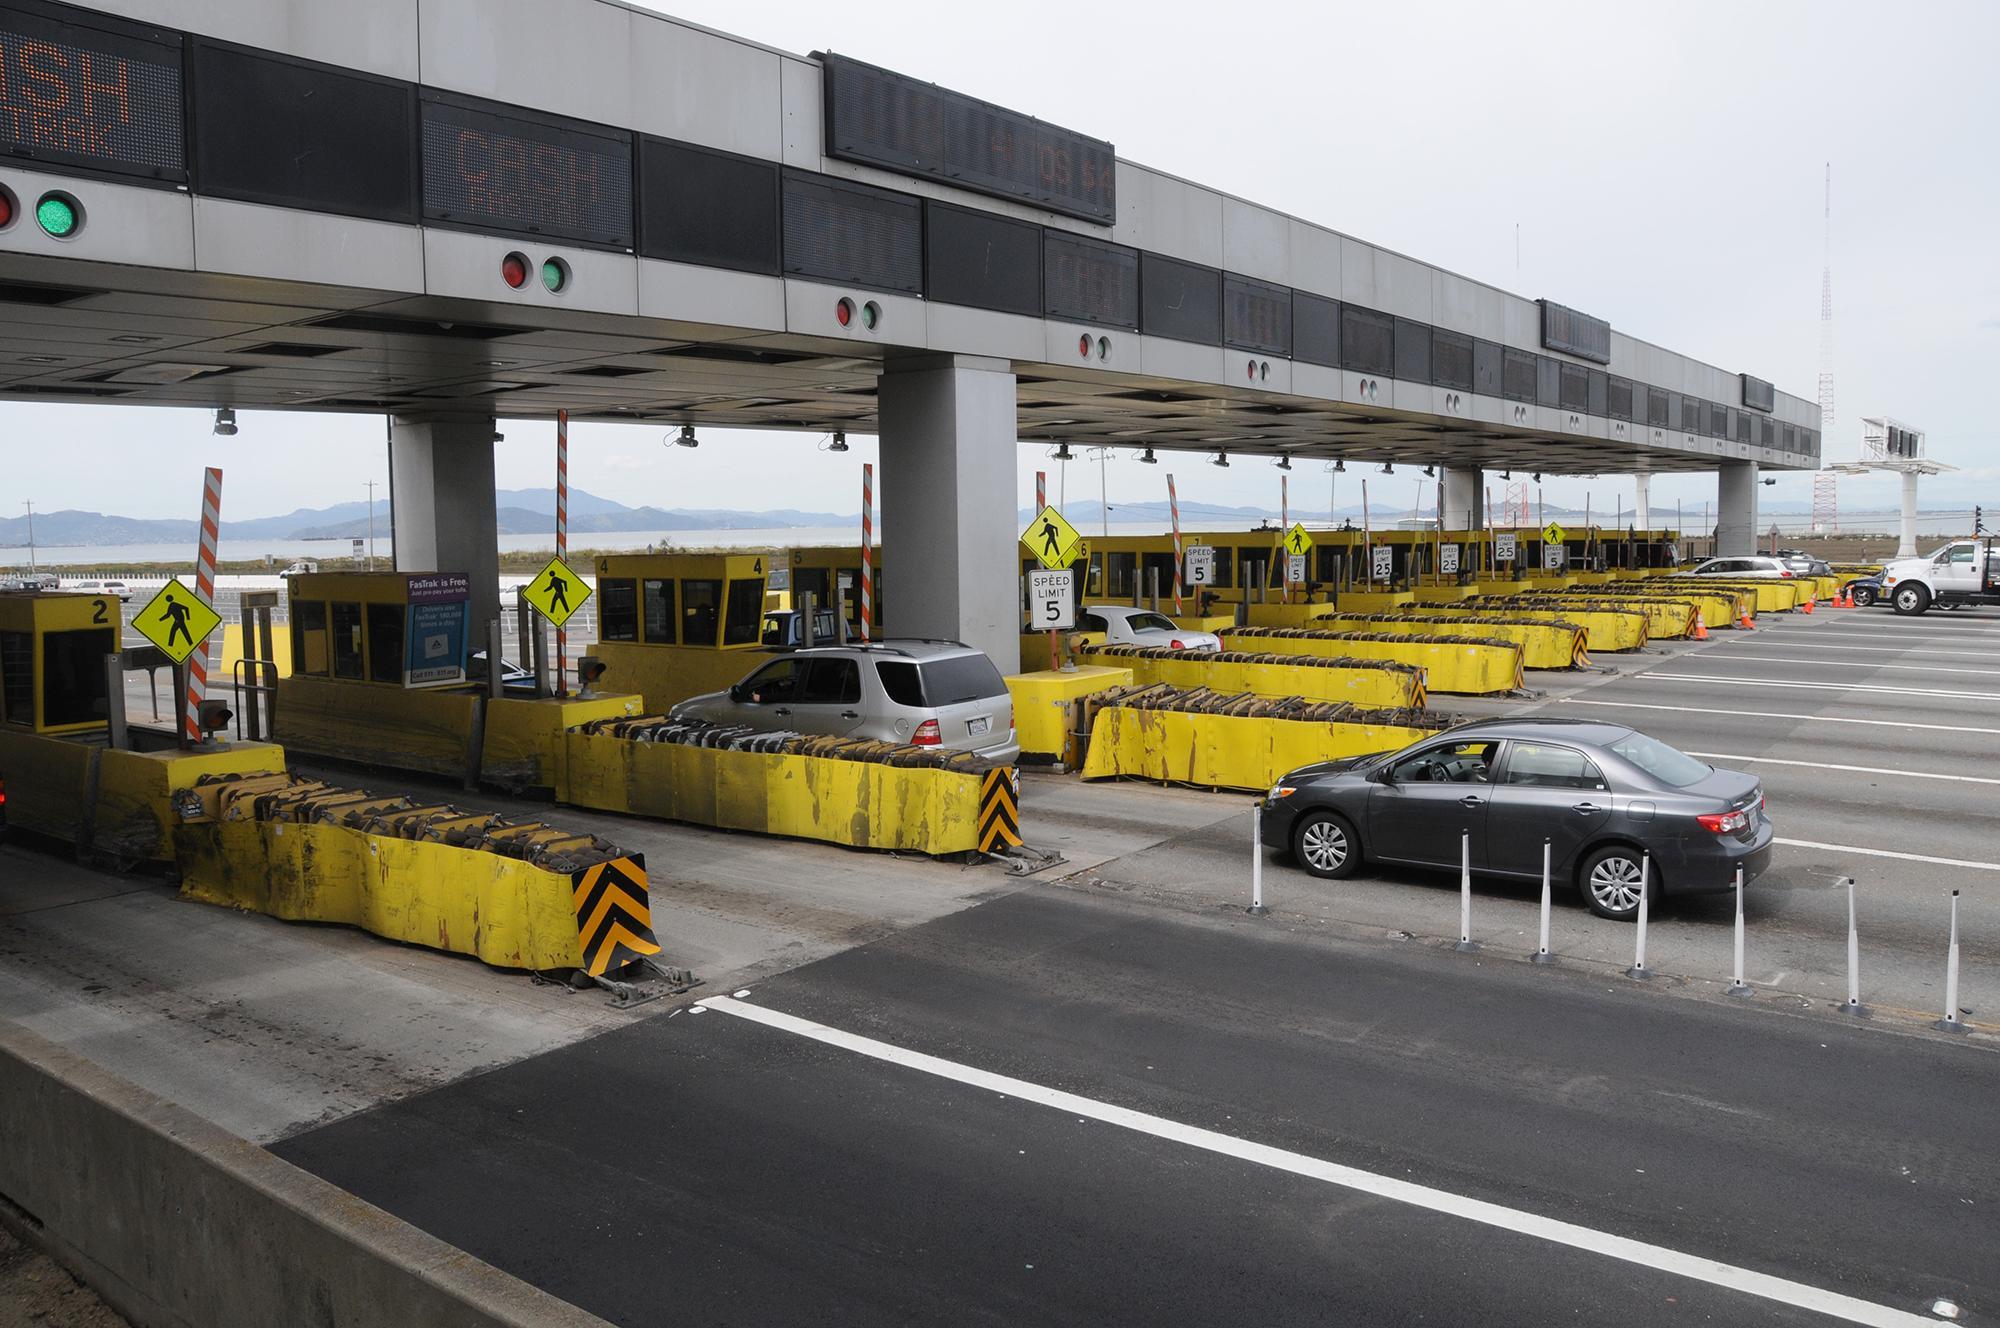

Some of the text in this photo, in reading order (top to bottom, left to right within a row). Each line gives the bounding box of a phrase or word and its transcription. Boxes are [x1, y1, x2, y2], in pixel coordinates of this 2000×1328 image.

[457, 129, 599, 203] CASH
[1081, 543, 1087, 556] 6
[1497, 547, 1514, 557] 25
[794, 551, 802, 564] 5
[1551, 557, 1558, 567] 5
[600, 558, 609, 574] 4
[753, 557, 763, 575] 4
[1375, 563, 1391, 576] 25
[1443, 560, 1457, 571] 25
[1195, 567, 1205, 581] 5
[1293, 569, 1300, 580] 5
[292, 579, 299, 596] 3
[409, 578, 469, 589] FasTrak is Free.
[1034, 576, 1070, 587] SPEED
[1038, 588, 1066, 599] LIMIT
[92, 599, 109, 625] 2
[1046, 600, 1061, 621] 5
